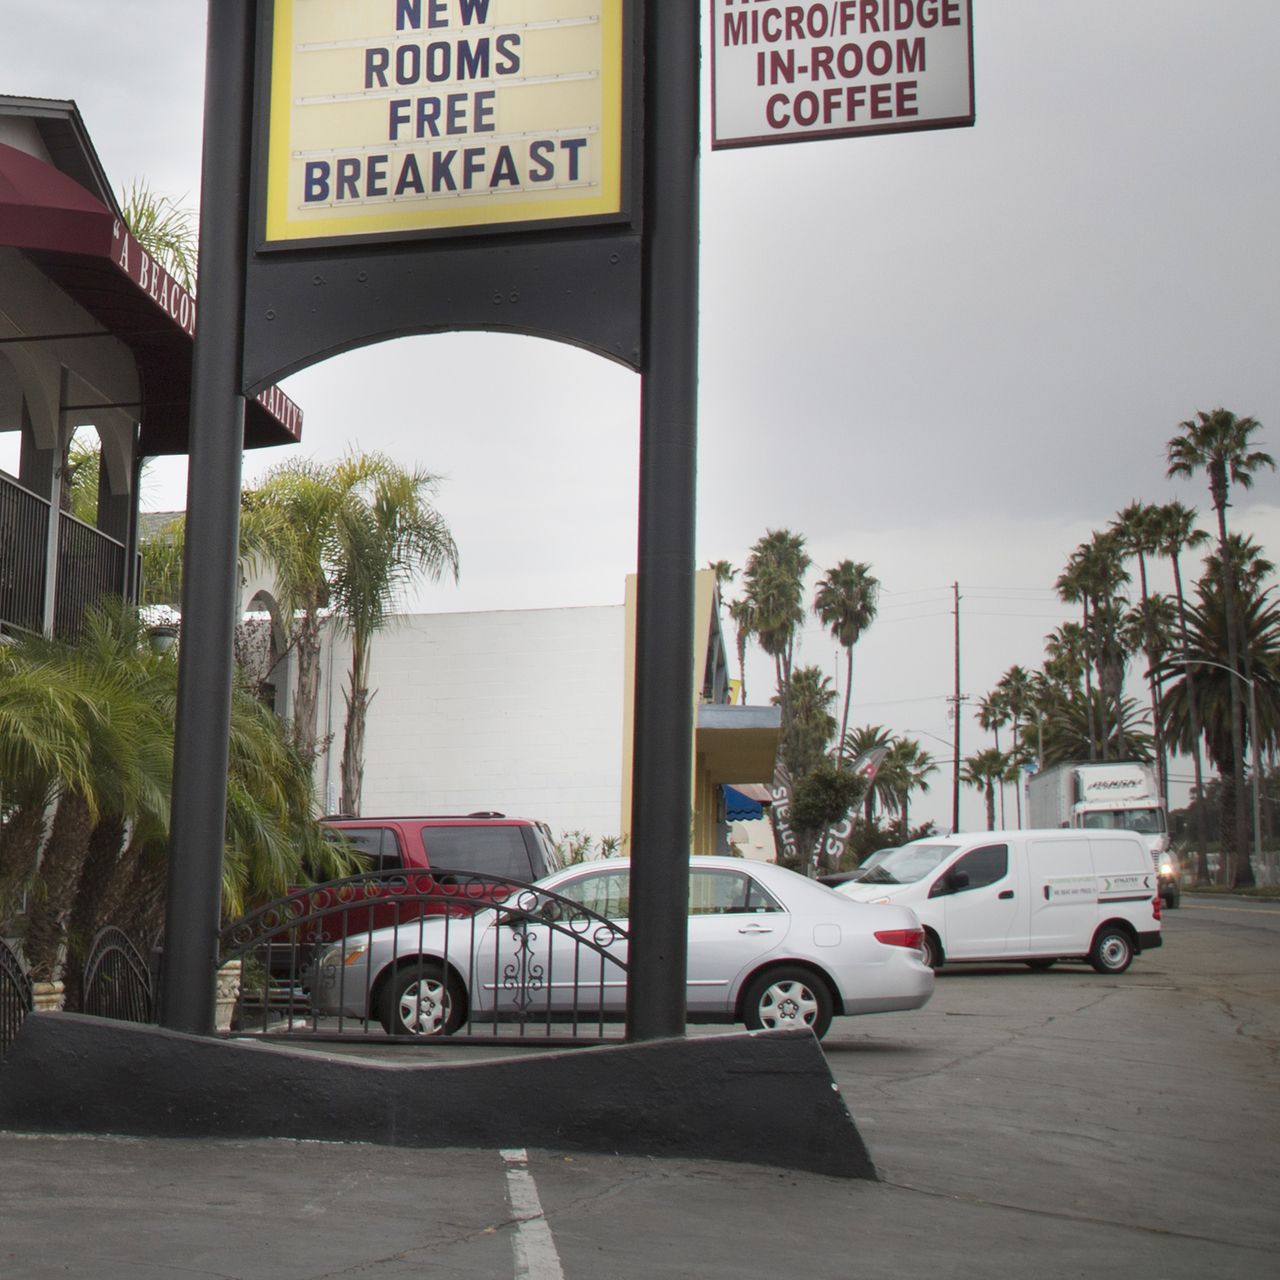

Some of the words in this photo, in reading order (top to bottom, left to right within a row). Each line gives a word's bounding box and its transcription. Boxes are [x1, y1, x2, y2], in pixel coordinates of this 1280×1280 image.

[365, 33, 521, 89] ROOMS
[757, 37, 926, 86] IN-ROOM
[389, 90, 496, 141] FREE
[766, 81, 918, 129] COFFEE
[304, 138, 587, 202] BREAKFAST
[771, 785, 797, 858] entals
